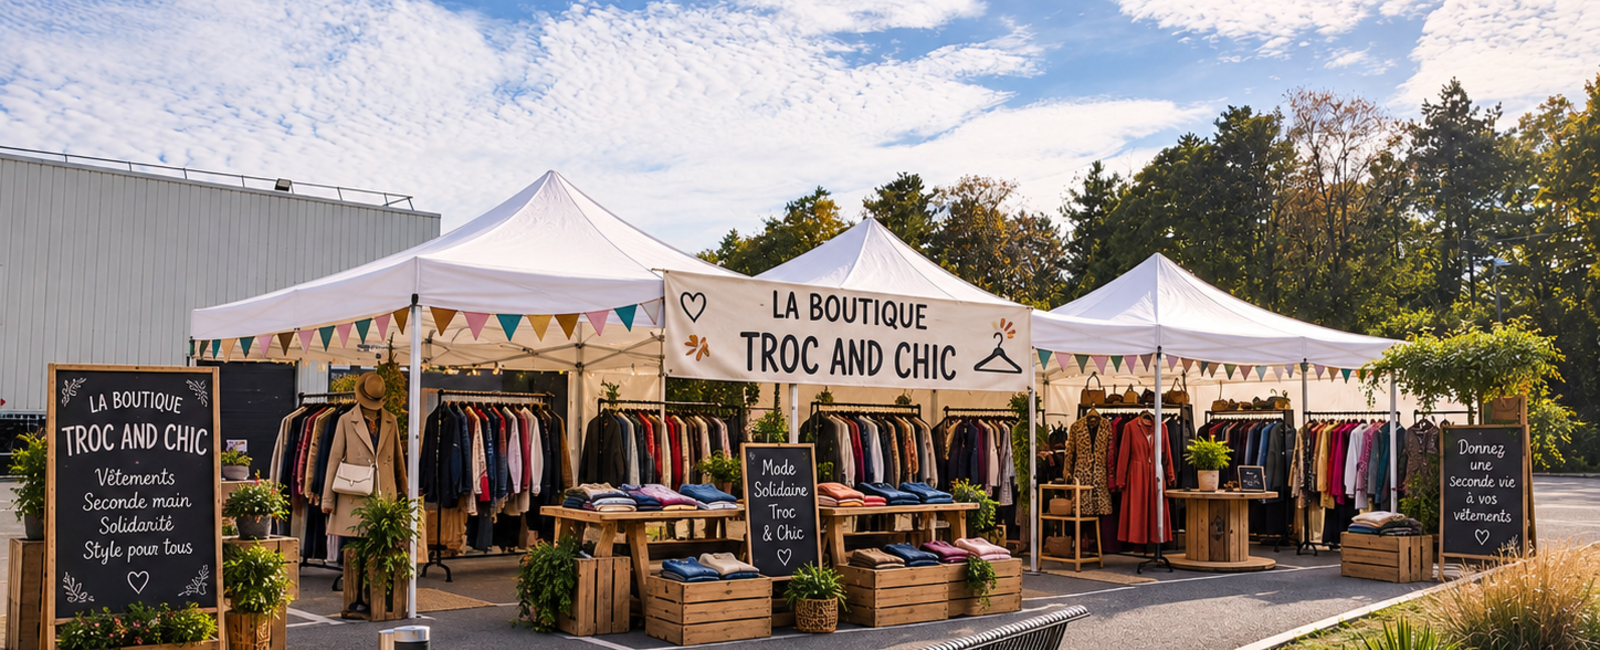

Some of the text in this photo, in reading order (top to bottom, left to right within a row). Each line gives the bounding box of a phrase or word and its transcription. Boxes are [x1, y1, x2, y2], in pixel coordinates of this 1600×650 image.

[773, 290, 927, 330] LA BOUTIQUE
[740, 332, 956, 380] TROC AND CHIC
[90, 391, 182, 413] LA BOUTIQUE
[62, 423, 207, 456] TROC AND CHIC
[1457, 439, 1506, 459] Donnez
[762, 459, 796, 475] Mode
[1470, 462, 1493, 471] une
[95, 468, 175, 486] Vêtements
[1498, 476, 1516, 488] vie
[83, 492, 191, 511] Seconde main
[1465, 492, 1498, 505] à vos
[769, 504, 795, 519] Troc
[763, 525, 804, 541] & Chic
[83, 538, 192, 565] Style pour tous
